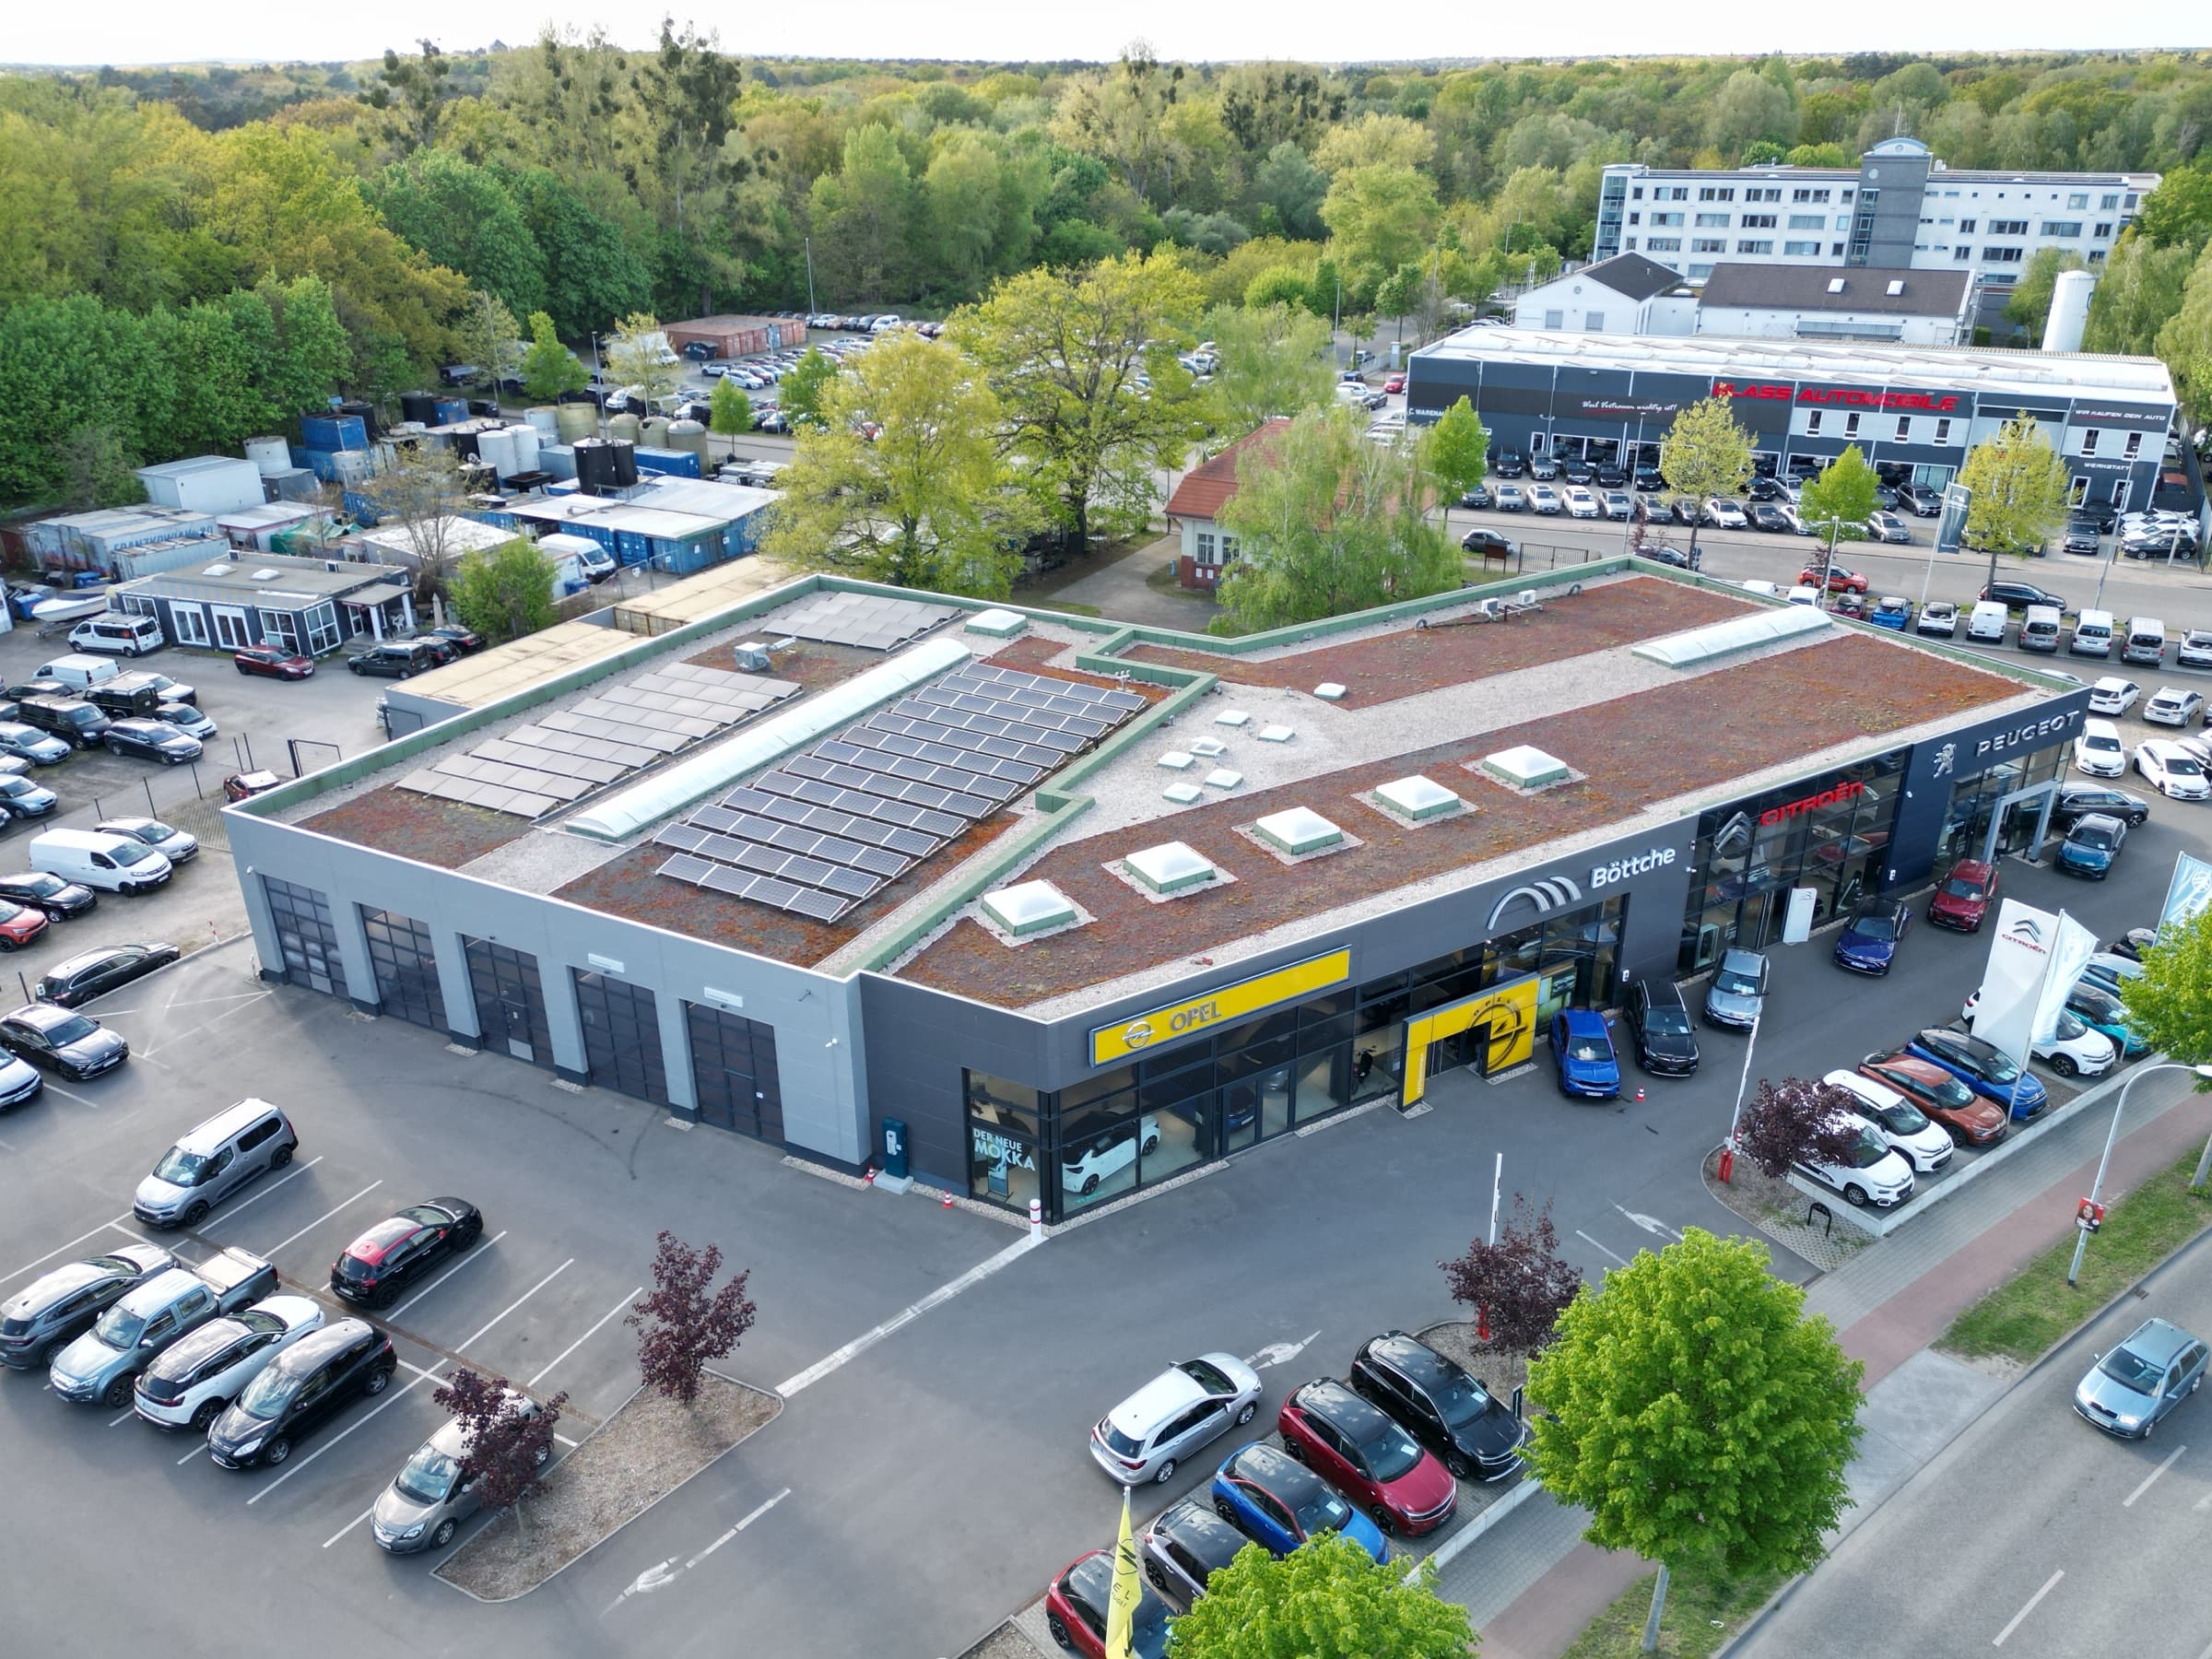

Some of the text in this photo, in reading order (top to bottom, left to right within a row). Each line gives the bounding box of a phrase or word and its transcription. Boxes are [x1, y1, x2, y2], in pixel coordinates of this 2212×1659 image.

[1797, 387, 1960, 411] AUTOMOBILE
[1976, 711, 2080, 757] PEUGEOT
[1591, 847, 1676, 888] Böttche
[1170, 1001, 1222, 1031] OPEL
[972, 1127, 1023, 1152] DER NEUE
[974, 1138, 1036, 1171] MOKKA
